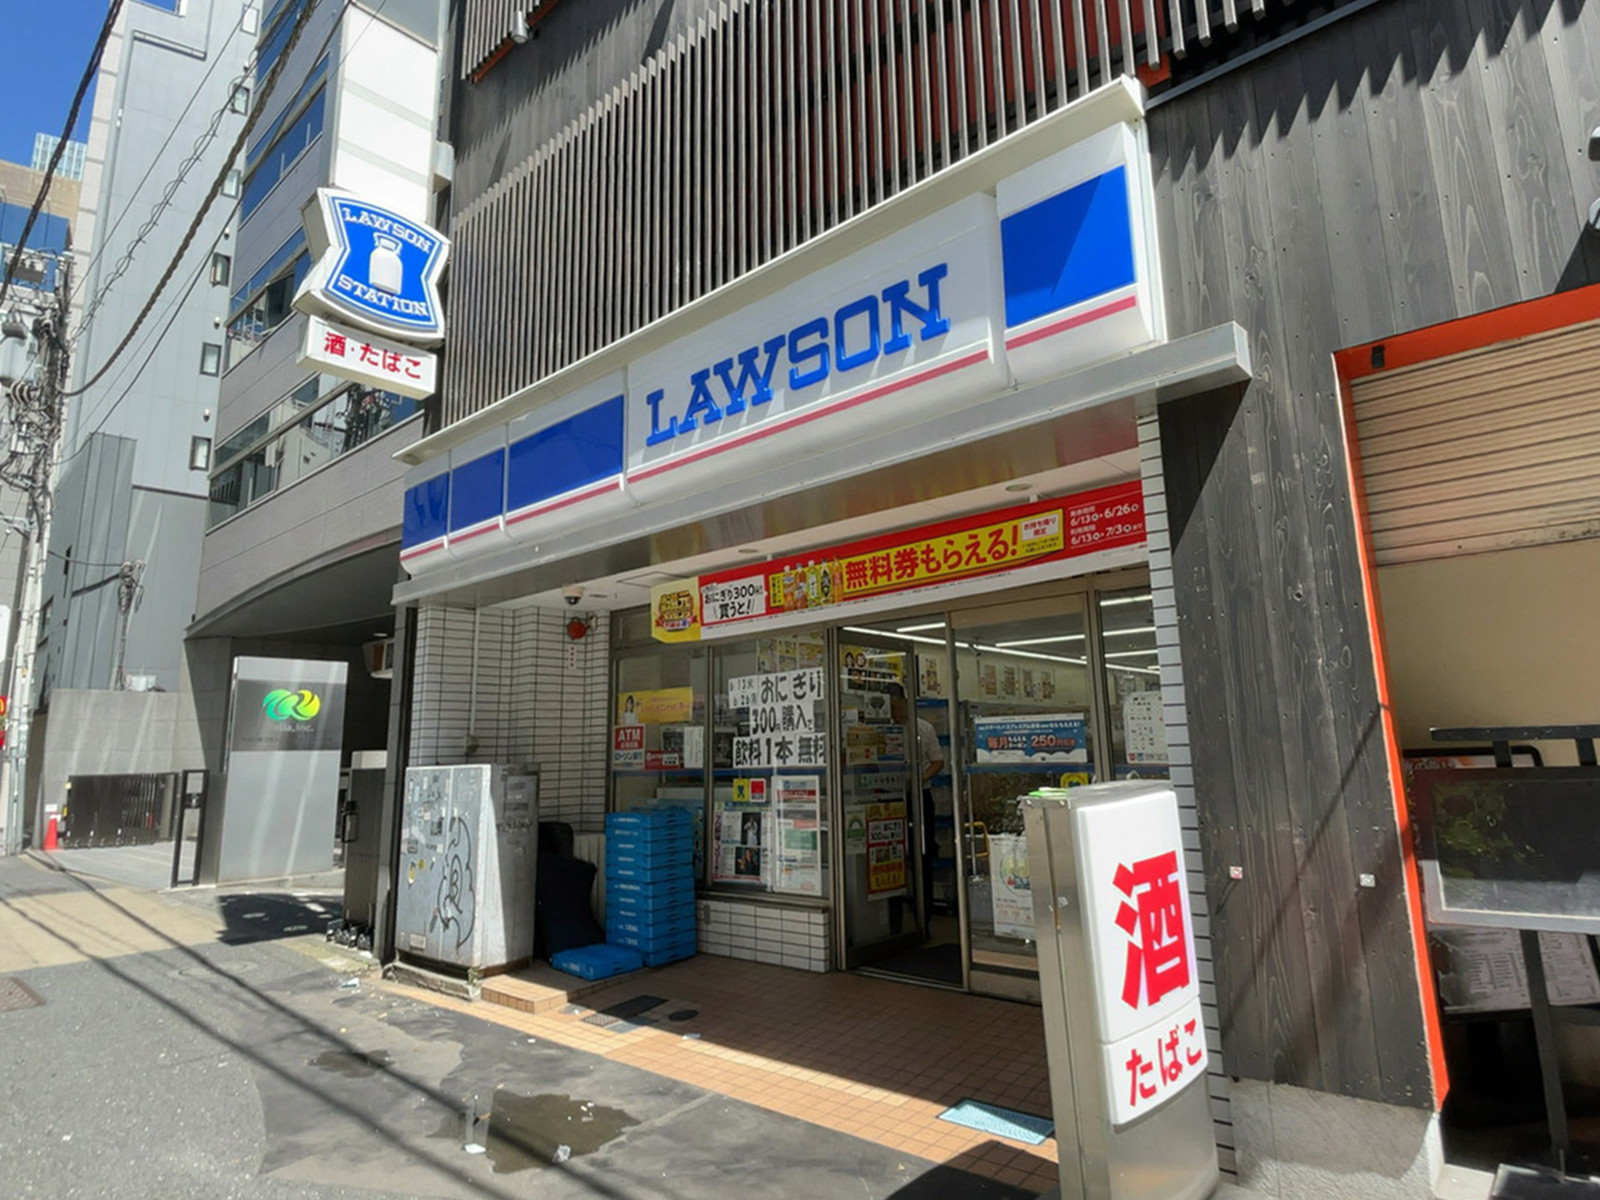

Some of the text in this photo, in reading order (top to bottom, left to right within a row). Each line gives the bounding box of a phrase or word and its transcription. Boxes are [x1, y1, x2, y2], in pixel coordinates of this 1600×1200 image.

[342, 206, 432, 254] LAWSON
[337, 273, 429, 317] STATION
[646, 263, 949, 446] LAWSON
[761, 671, 822, 703] おにぎり
[617, 728, 641, 742] ATM
[1112, 850, 1190, 1010] 酒
[1125, 1018, 1203, 1107] たばこ
